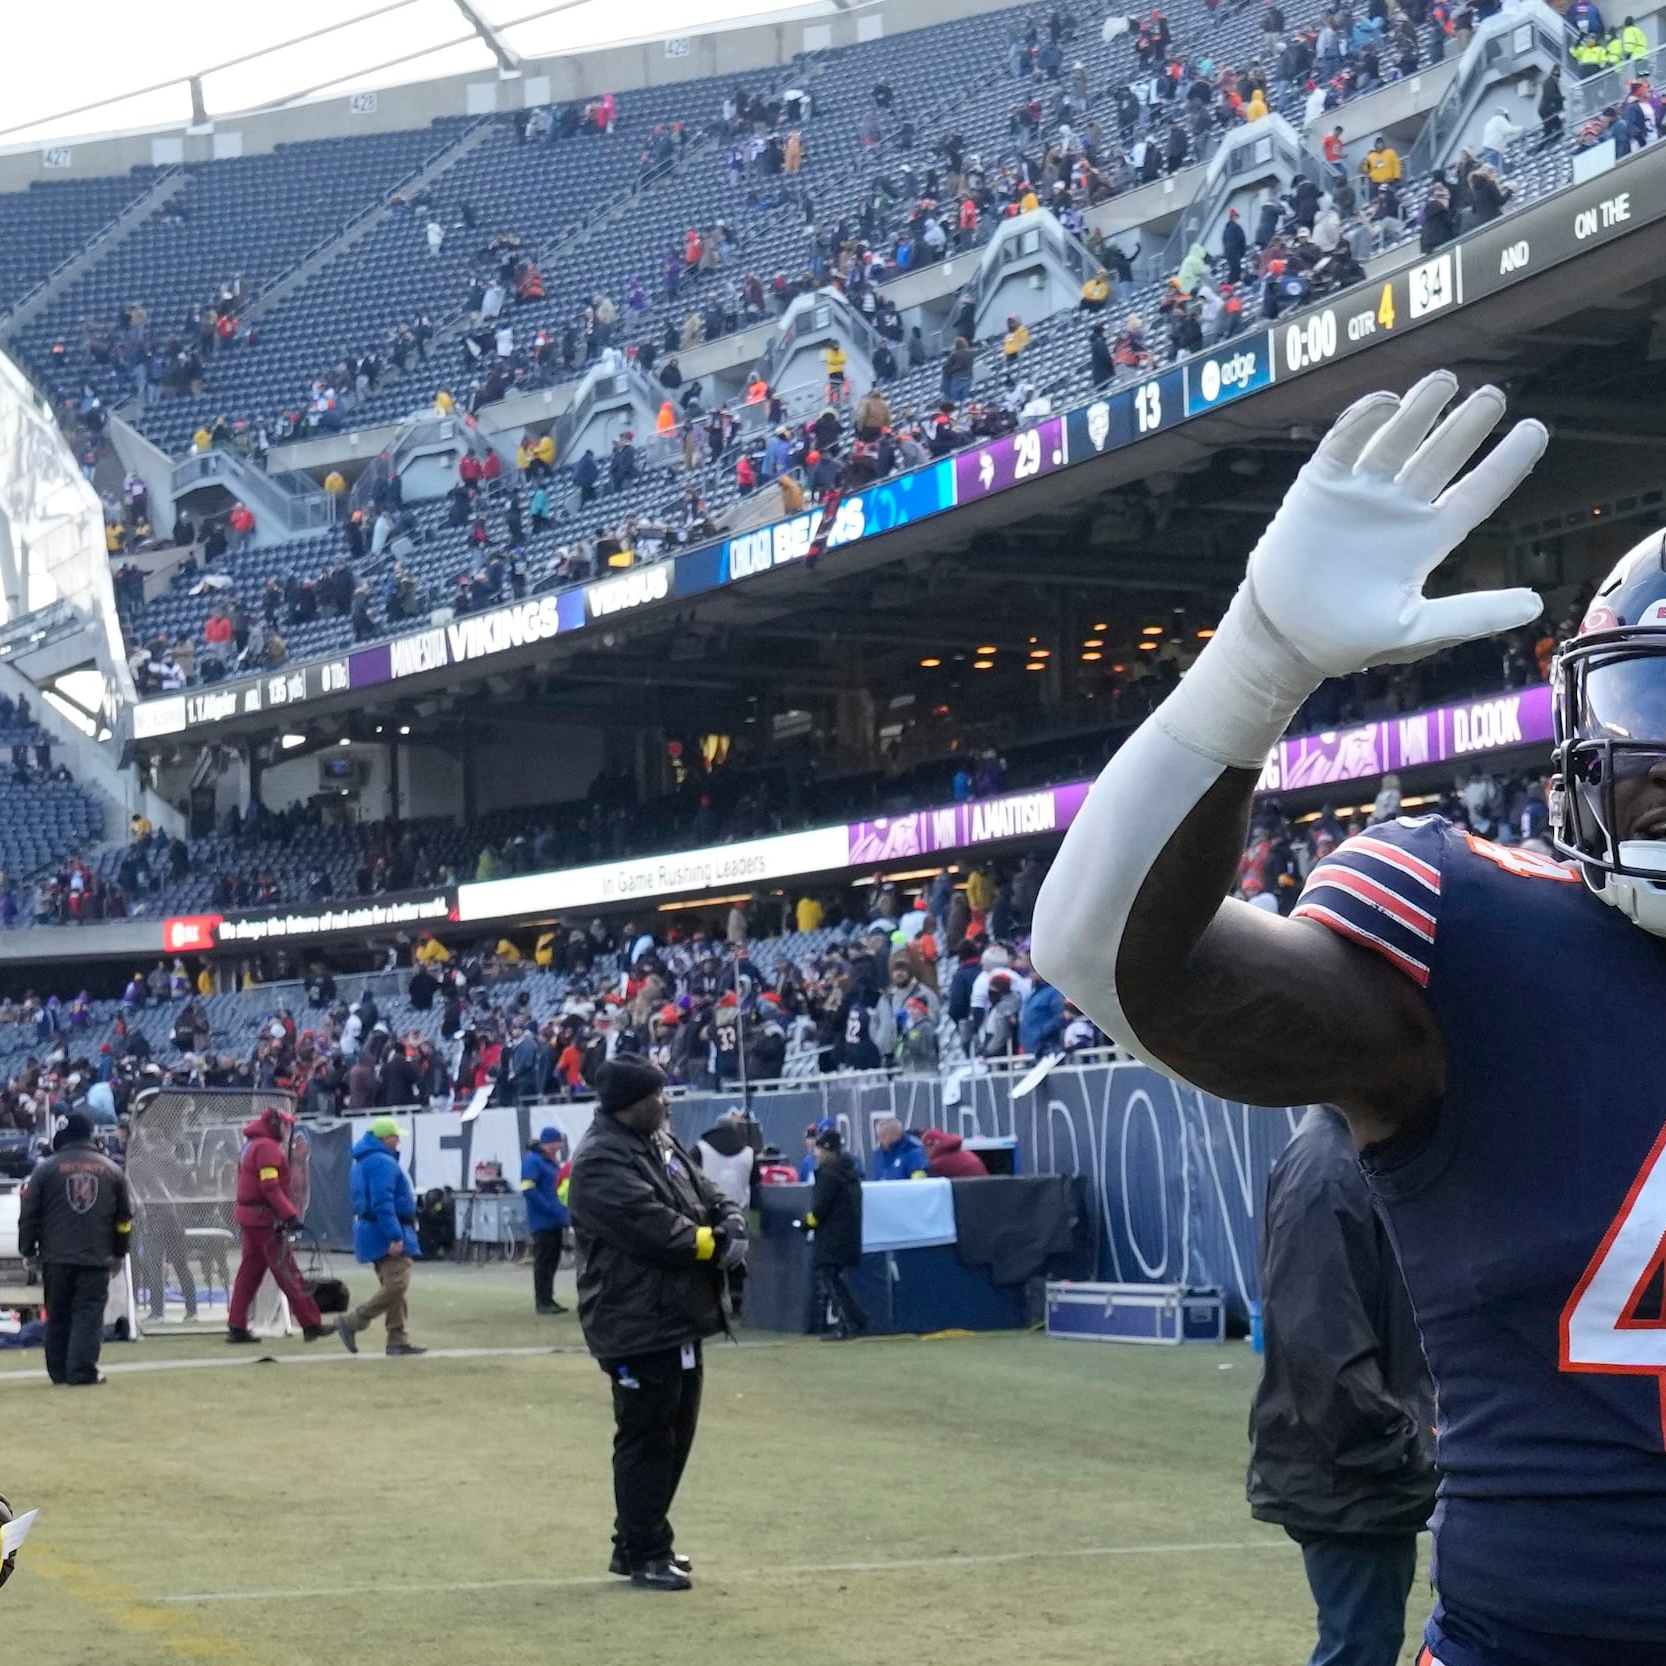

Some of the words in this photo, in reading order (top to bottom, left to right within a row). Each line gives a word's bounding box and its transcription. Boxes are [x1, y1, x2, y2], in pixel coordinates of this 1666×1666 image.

[1013, 429, 1041, 479] 29
[1135, 381, 1161, 433] 13
[1220, 350, 1257, 389] edge
[1286, 309, 1337, 372] 0:00
[1347, 311, 1376, 341] QTR
[1378, 282, 1395, 330] 4
[1418, 262, 1442, 310] 34
[1499, 240, 1530, 275] AND
[1574, 206, 1598, 240] ON
[1599, 192, 1632, 228] THE
[729, 528, 773, 580] CHICAGO
[587, 560, 669, 618] VERSUS
[390, 628, 448, 679] MINNESOTA
[449, 596, 560, 662] VIKINGS
[1454, 696, 1523, 750] D.COOK
[971, 791, 1055, 842] A.MATTISON
[602, 872, 614, 895] In
[618, 869, 654, 893] Game
[658, 862, 712, 887] Rushing
[716, 853, 766, 880] Leaders
